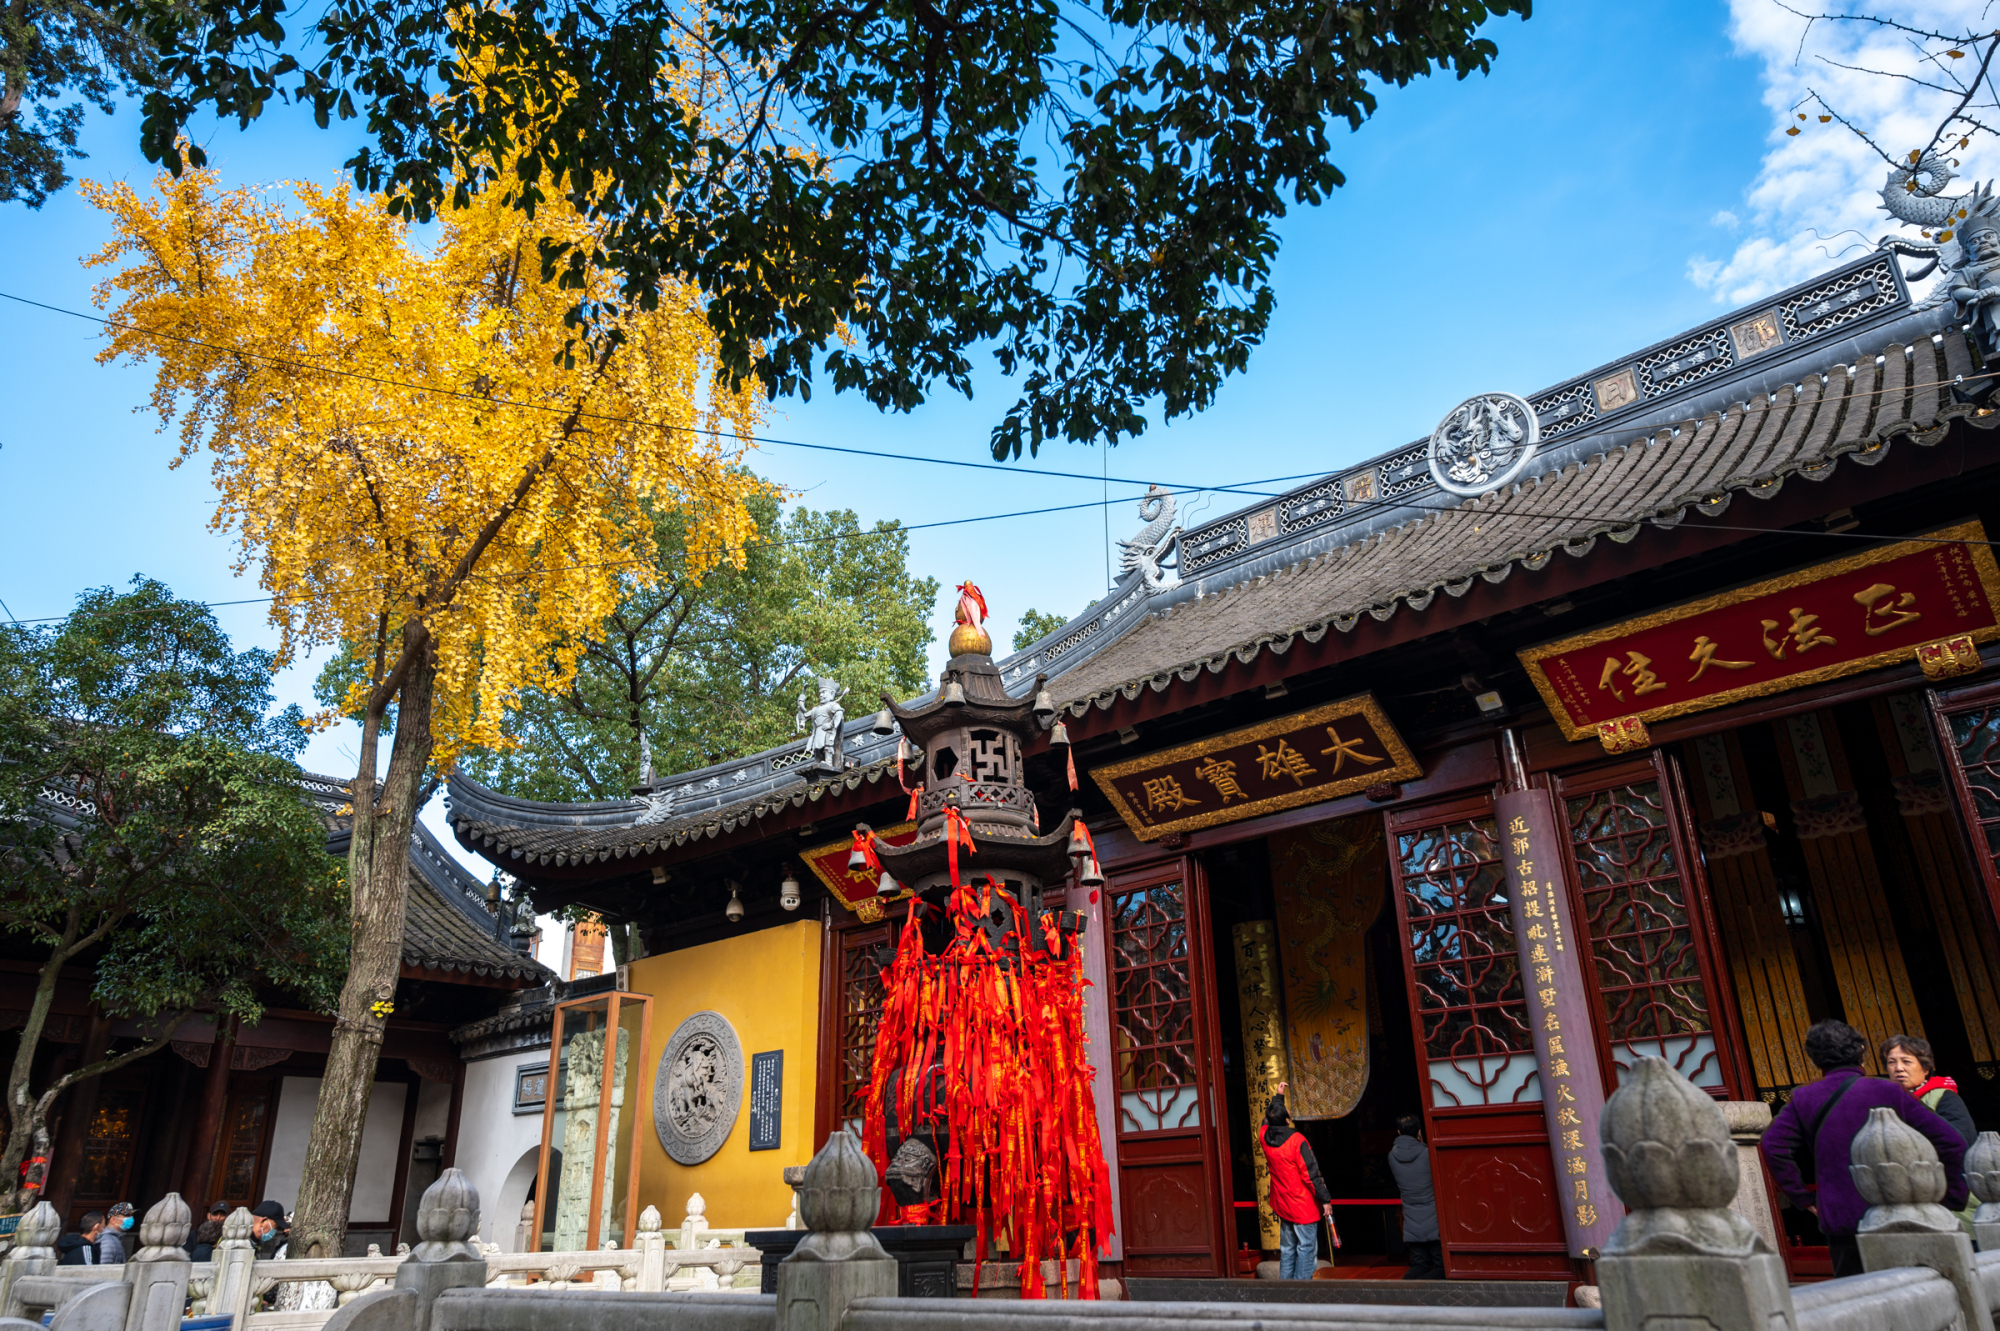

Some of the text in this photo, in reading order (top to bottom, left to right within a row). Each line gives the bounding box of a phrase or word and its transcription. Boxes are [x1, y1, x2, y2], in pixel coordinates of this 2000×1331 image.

[1597, 583, 1922, 702] 正法久住
[1142, 726, 1384, 813] 大雄寶殿
